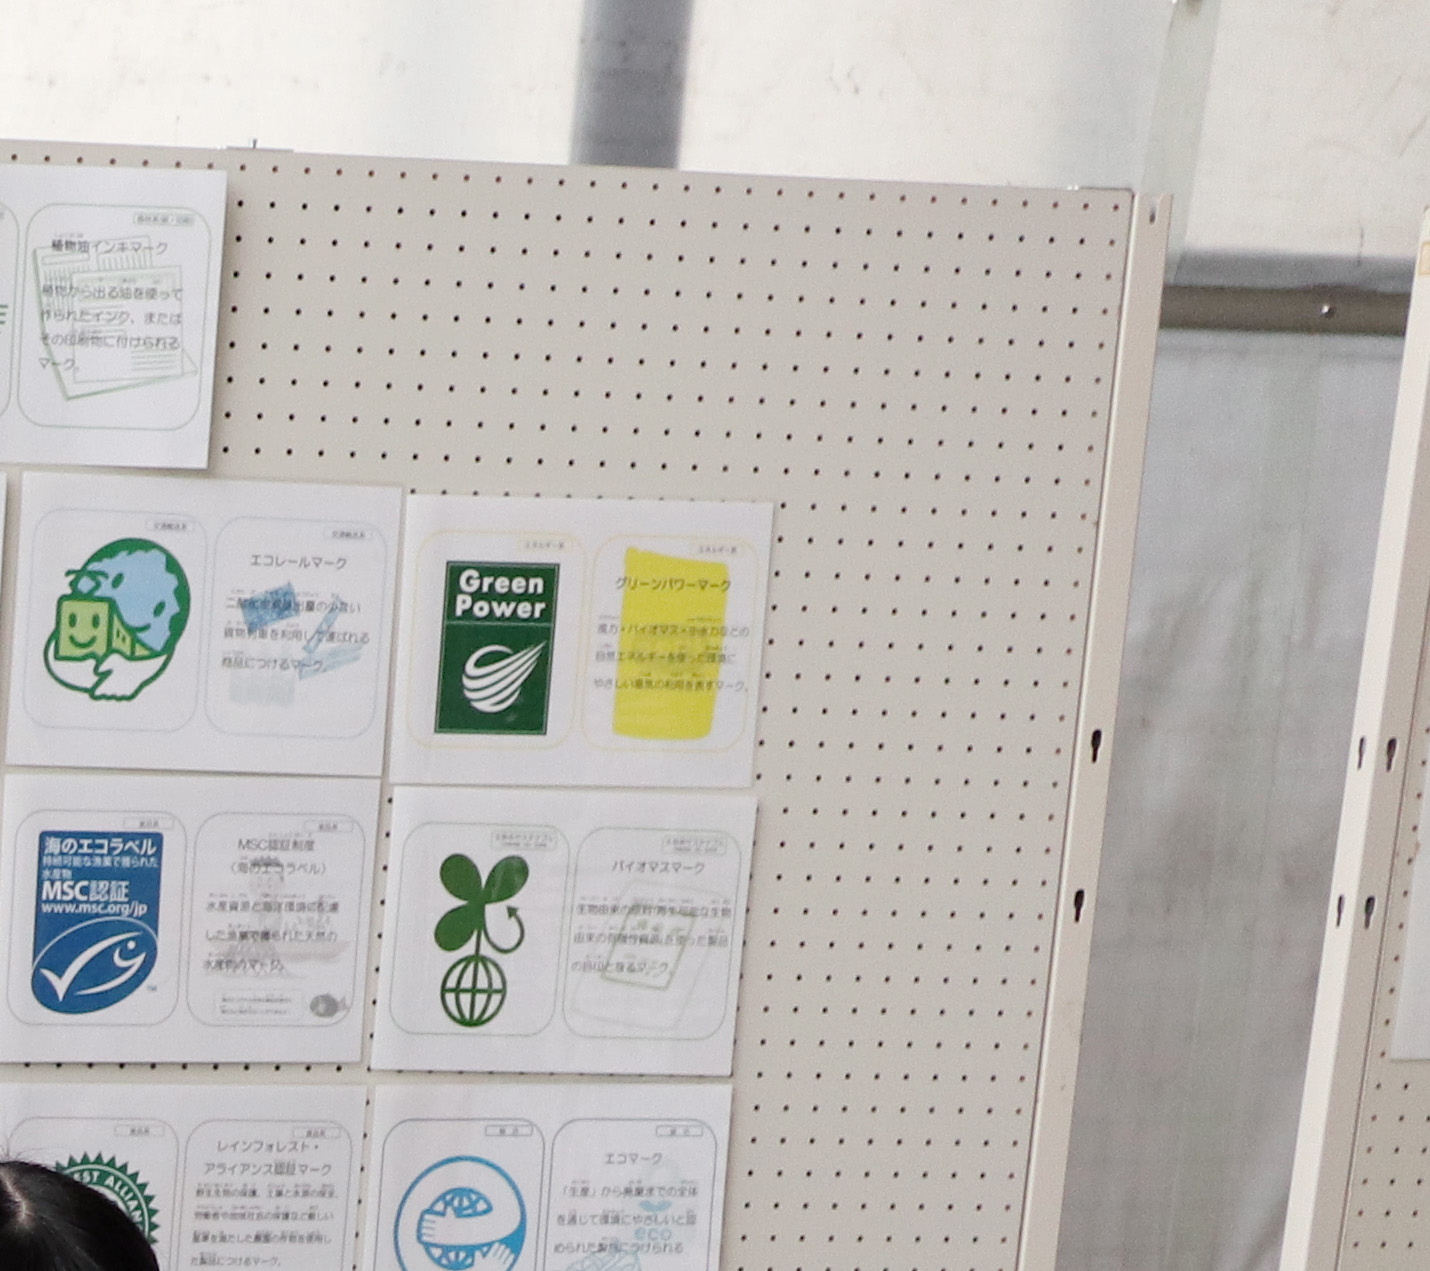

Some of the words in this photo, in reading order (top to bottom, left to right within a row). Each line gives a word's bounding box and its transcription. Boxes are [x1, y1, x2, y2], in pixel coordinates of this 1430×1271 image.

[250, 554, 348, 570] エコレールマーク
[459, 569, 545, 596] Green
[615, 575, 731, 592] グリーンパワーマーク
[454, 595, 546, 620] Power
[43, 836, 157, 856] 海のエコラベル
[611, 859, 706, 875] バイオマスマーク
[42, 880, 130, 903] MSC認証
[41, 902, 148, 919] www.msc.org/jp
[604, 1152, 663, 1167] エコマーク
